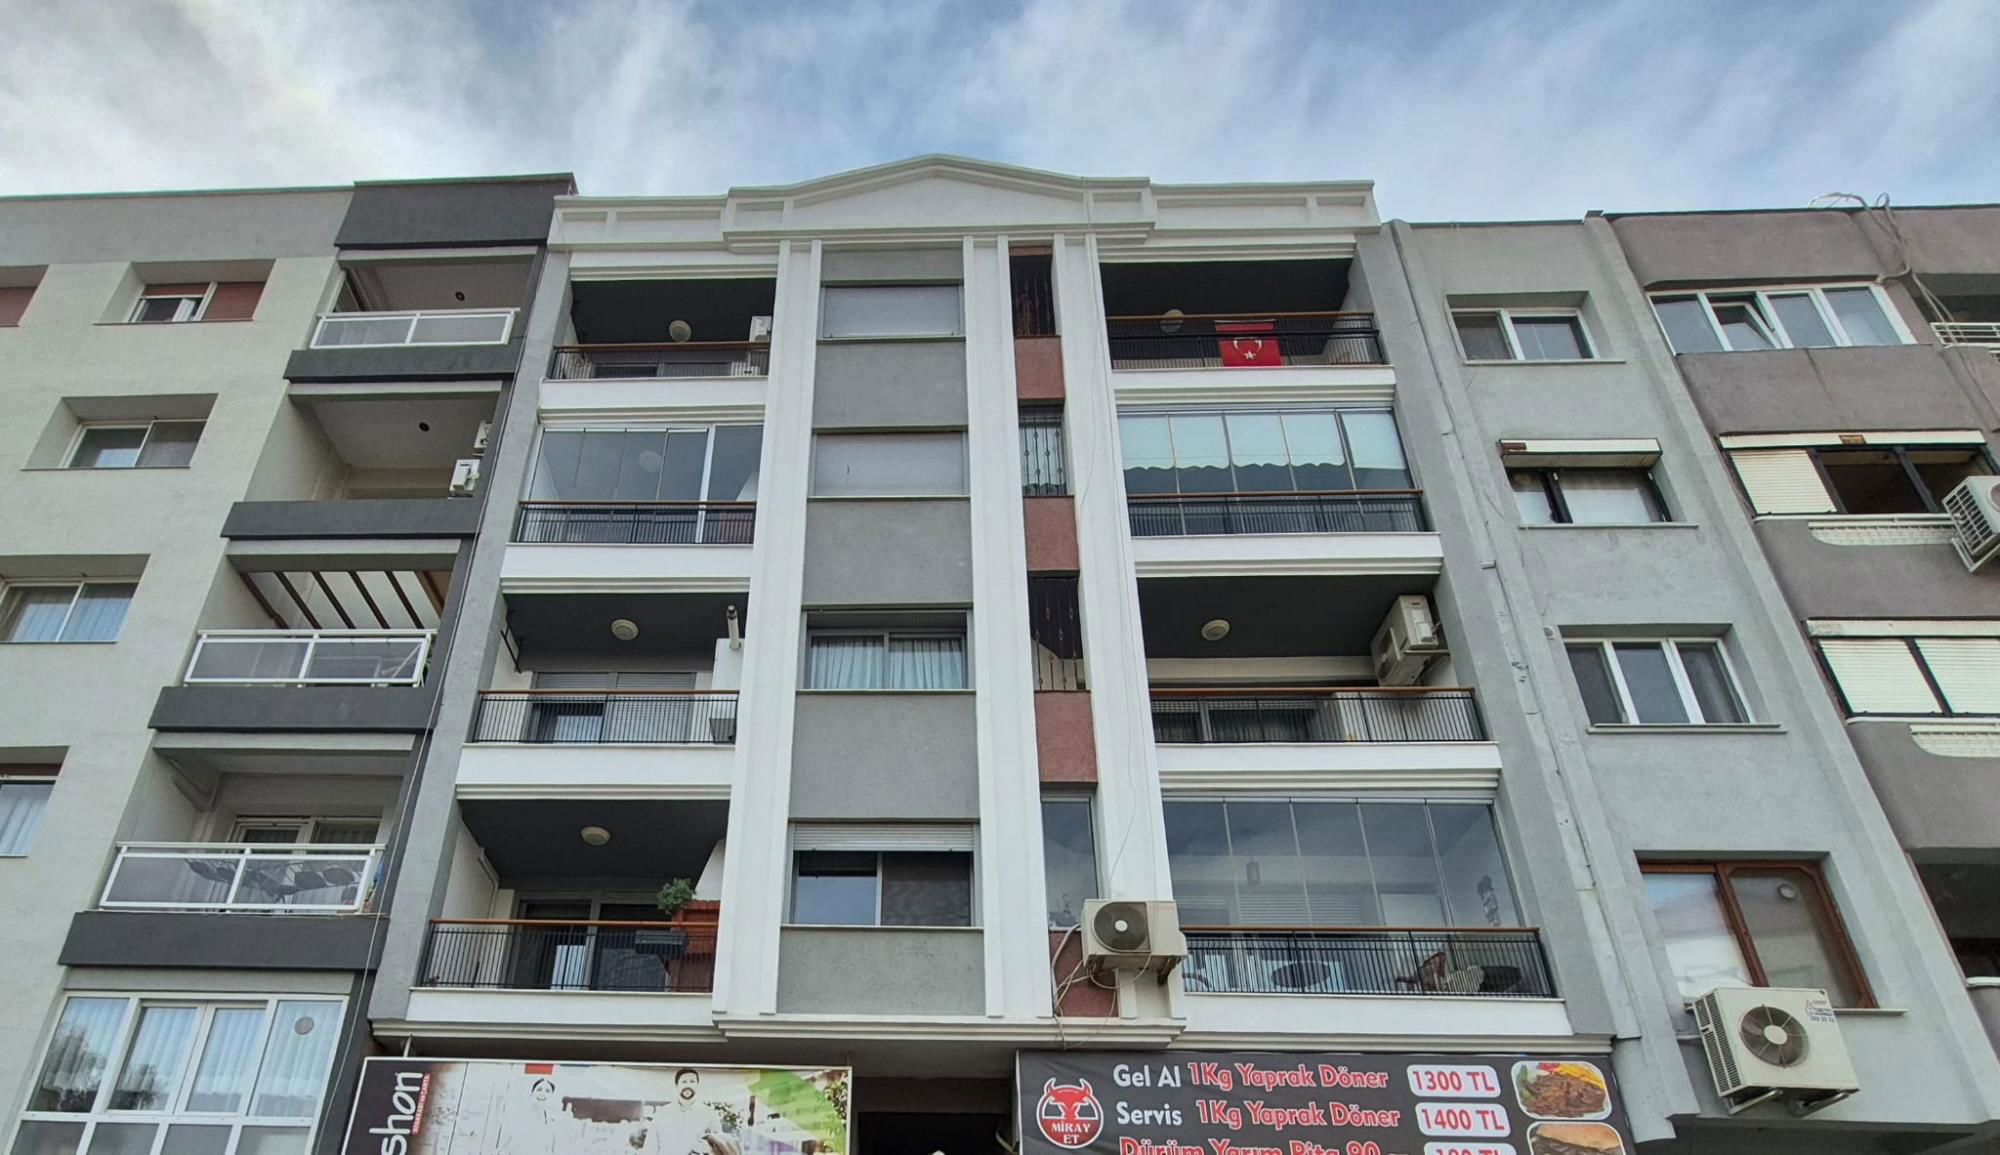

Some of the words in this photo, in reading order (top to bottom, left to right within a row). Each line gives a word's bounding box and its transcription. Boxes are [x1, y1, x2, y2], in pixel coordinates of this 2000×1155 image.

[1113, 1063, 1150, 1087] Gel
[1188, 1062, 1233, 1091] 1Kg
[1234, 1063, 1317, 1092] Yaprak
[1318, 1064, 1388, 1088] Döner
[1413, 1071, 1462, 1091] 1300
[1466, 1072, 1495, 1091] TL
[1116, 1101, 1182, 1126] Servis
[1196, 1100, 1242, 1130] 1Kg
[1243, 1101, 1327, 1131] Yaprak
[1329, 1102, 1400, 1127] Döner
[1421, 1109, 1472, 1130] 1400
[1476, 1110, 1505, 1130] TL
[1063, 1134, 1080, 1144] ET
